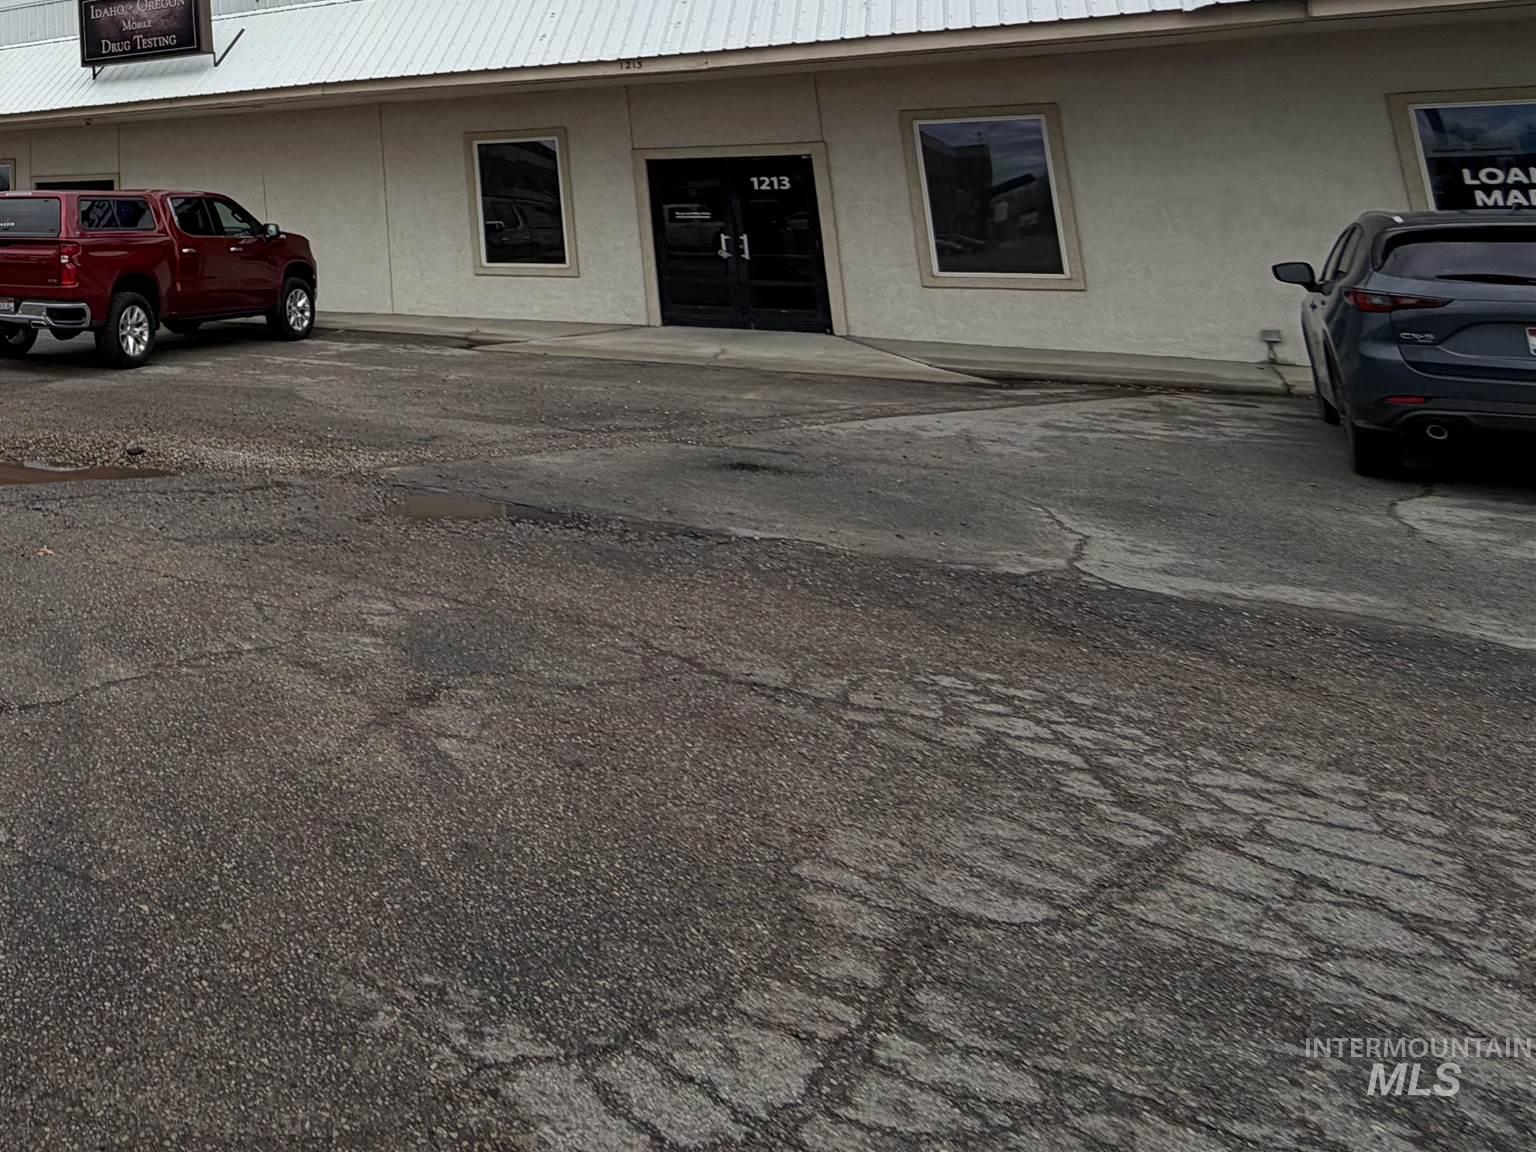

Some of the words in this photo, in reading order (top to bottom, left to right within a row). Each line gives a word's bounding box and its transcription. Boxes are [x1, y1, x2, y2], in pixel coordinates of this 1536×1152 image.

[90, 5, 124, 19] IDAHO
[101, 39, 131, 54] DRUG
[133, 34, 177, 49] TESTING
[750, 176, 791, 190] 1213
